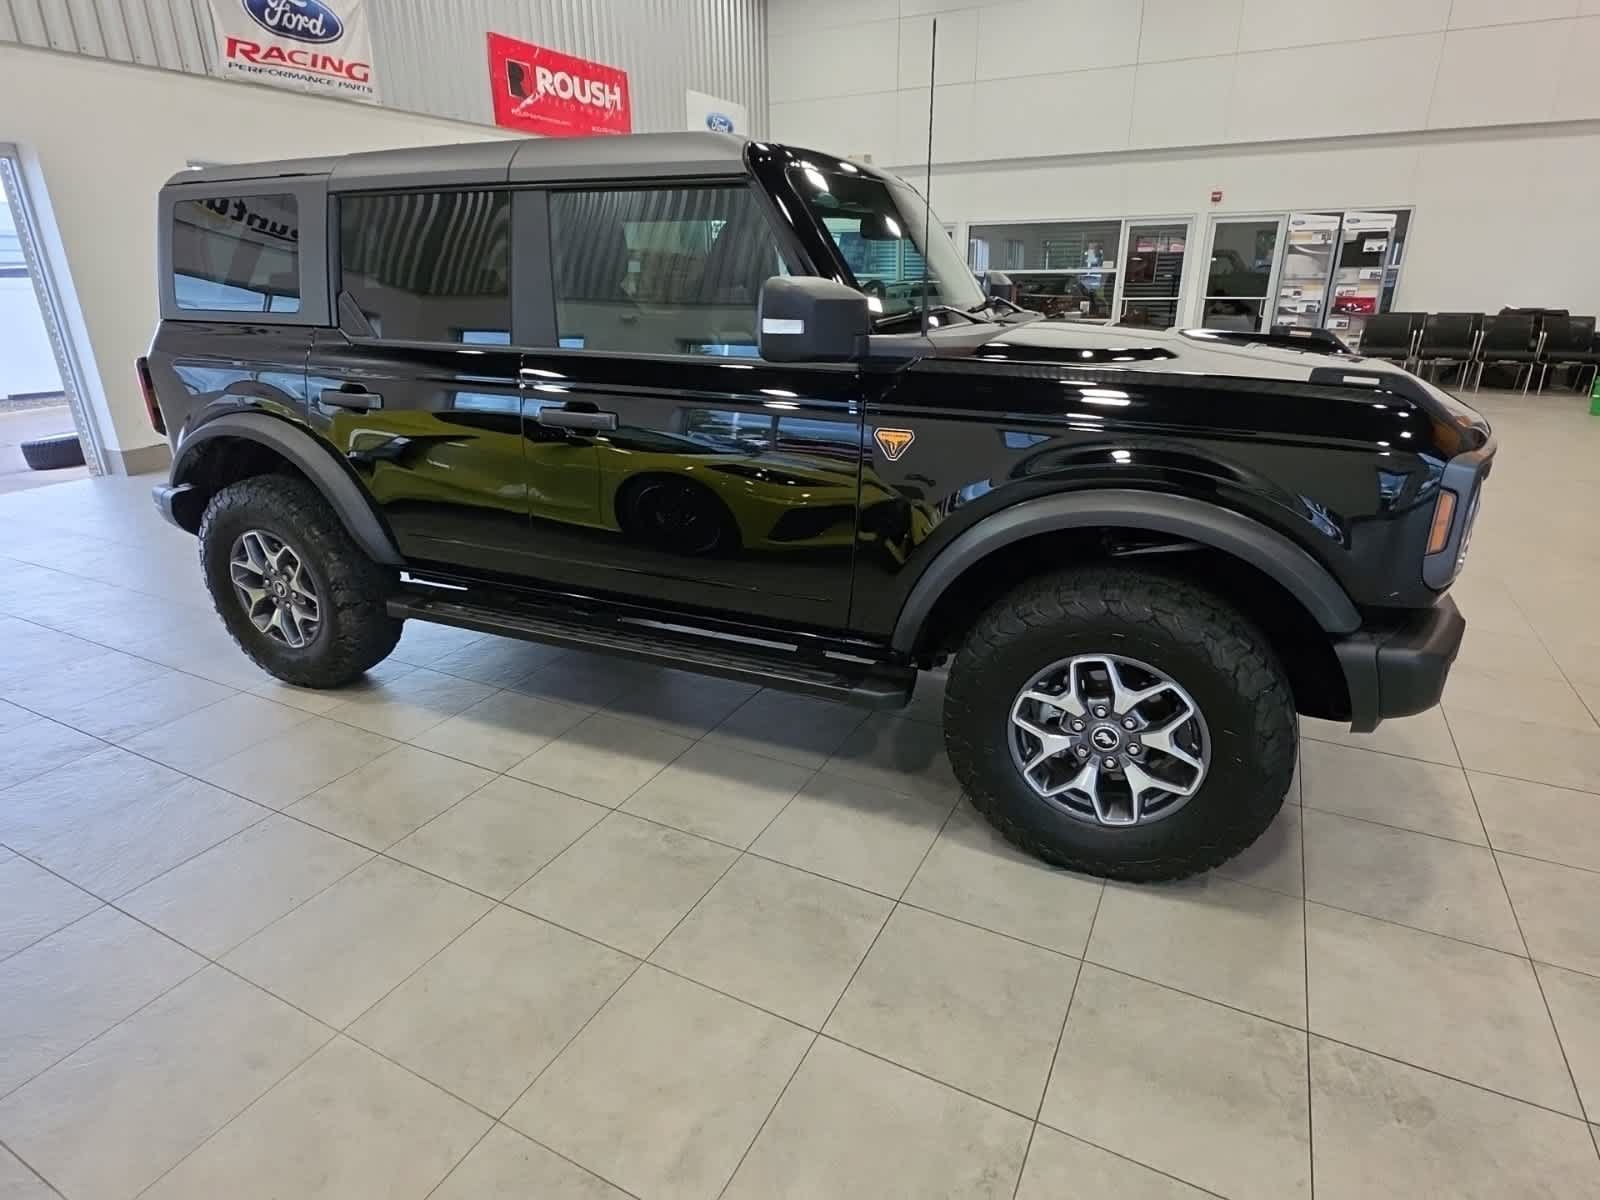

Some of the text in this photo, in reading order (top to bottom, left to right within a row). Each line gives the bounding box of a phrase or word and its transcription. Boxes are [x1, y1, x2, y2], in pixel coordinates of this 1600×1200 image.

[264, 0, 326, 36] Ford
[226, 37, 370, 82] RACING
[228, 61, 374, 94] PERFORMANCE PARTS
[535, 65, 622, 111] ROUSH
